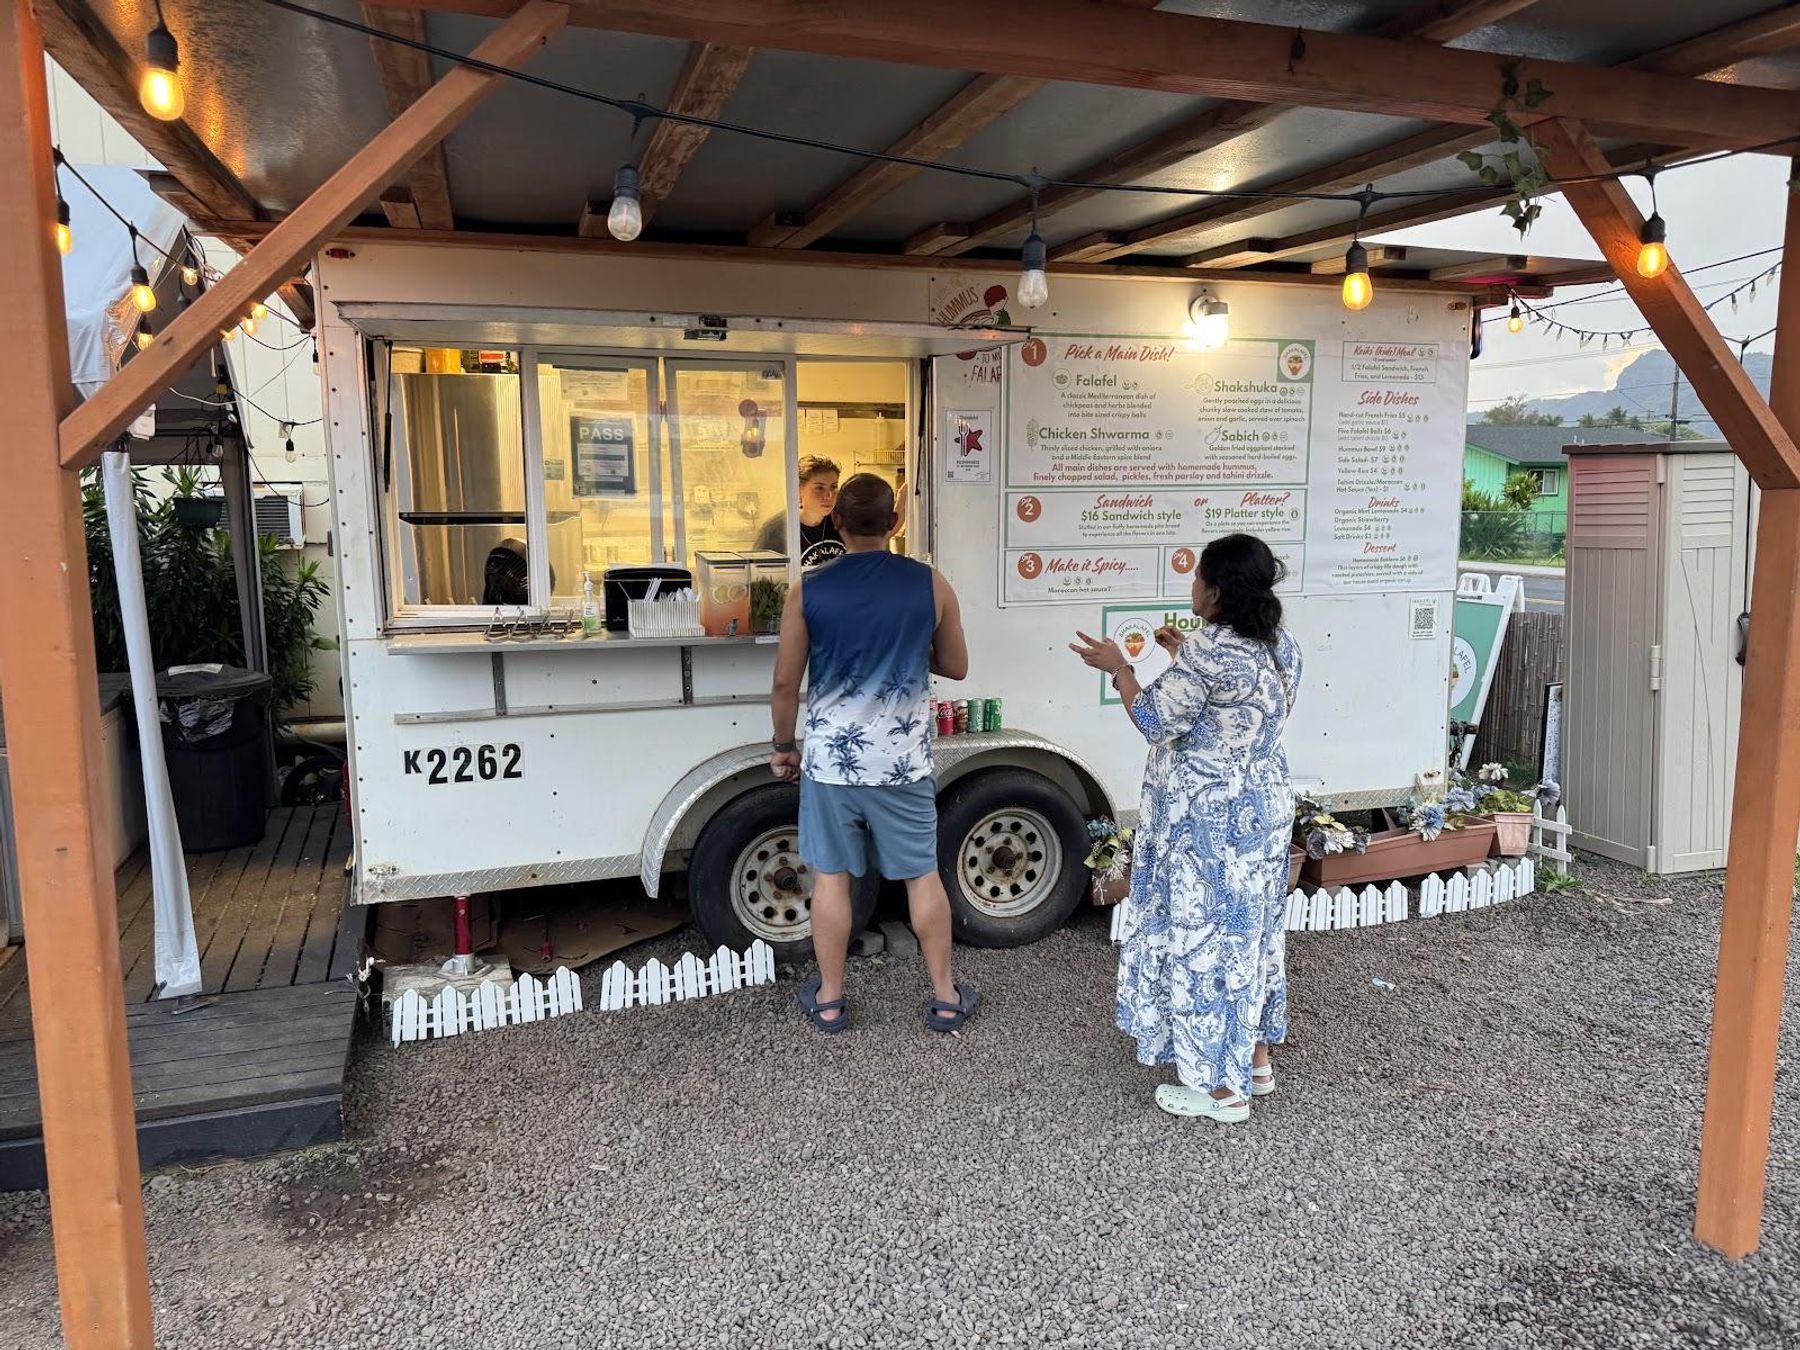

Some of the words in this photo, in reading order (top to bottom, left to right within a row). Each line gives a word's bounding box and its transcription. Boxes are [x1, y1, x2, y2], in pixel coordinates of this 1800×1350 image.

[936, 287, 978, 325] HUMMUS
[1032, 345, 1038, 360] 1
[1064, 344, 1093, 360] Pick
[1095, 350, 1102, 359] a
[1104, 345, 1137, 361] Main
[1140, 345, 1175, 362] Dish!
[1076, 374, 1117, 386] Falafel
[1214, 381, 1277, 393] Shakshuka
[1358, 391, 1382, 405] Side
[1384, 391, 1419, 405] Dishes
[580, 427, 624, 440] PASS
[1039, 427, 1087, 439] Chicken
[1090, 427, 1149, 439] Shwarma
[1222, 429, 1259, 441] Sabich
[1052, 463, 1063, 472] All
[1087, 463, 1111, 471] dishes
[1129, 463, 1155, 471] served
[1157, 463, 1176, 471] with
[1178, 462, 1221, 471] homemade
[1222, 462, 1257, 472] hummus,
[1033, 472, 1056, 483] finely
[1058, 472, 1092, 482] chopped
[1153, 471, 1173, 480] fresh
[1175, 472, 1204, 481] parsley
[1206, 471, 1220, 480] and
[1222, 471, 1244, 480] tahini
[1246, 471, 1273, 480] drizzle.
[1094, 494, 1153, 510] Sandwich
[1194, 497, 1208, 507] or
[1240, 491, 1291, 507] Platter?
[1368, 497, 1400, 508] Drinks
[1025, 503, 1034, 516] 2
[1081, 511, 1099, 522] $16
[1102, 510, 1154, 521] Sandwich
[1156, 508, 1182, 523] style
[1205, 508, 1221, 519] $19
[1224, 508, 1259, 518] Platter
[1261, 507, 1284, 520] style
[1364, 542, 1397, 553] Dessert
[1025, 560, 1035, 572] 3
[1045, 558, 1079, 574] Make
[1081, 559, 1092, 572] it
[1179, 555, 1188, 568] 4
